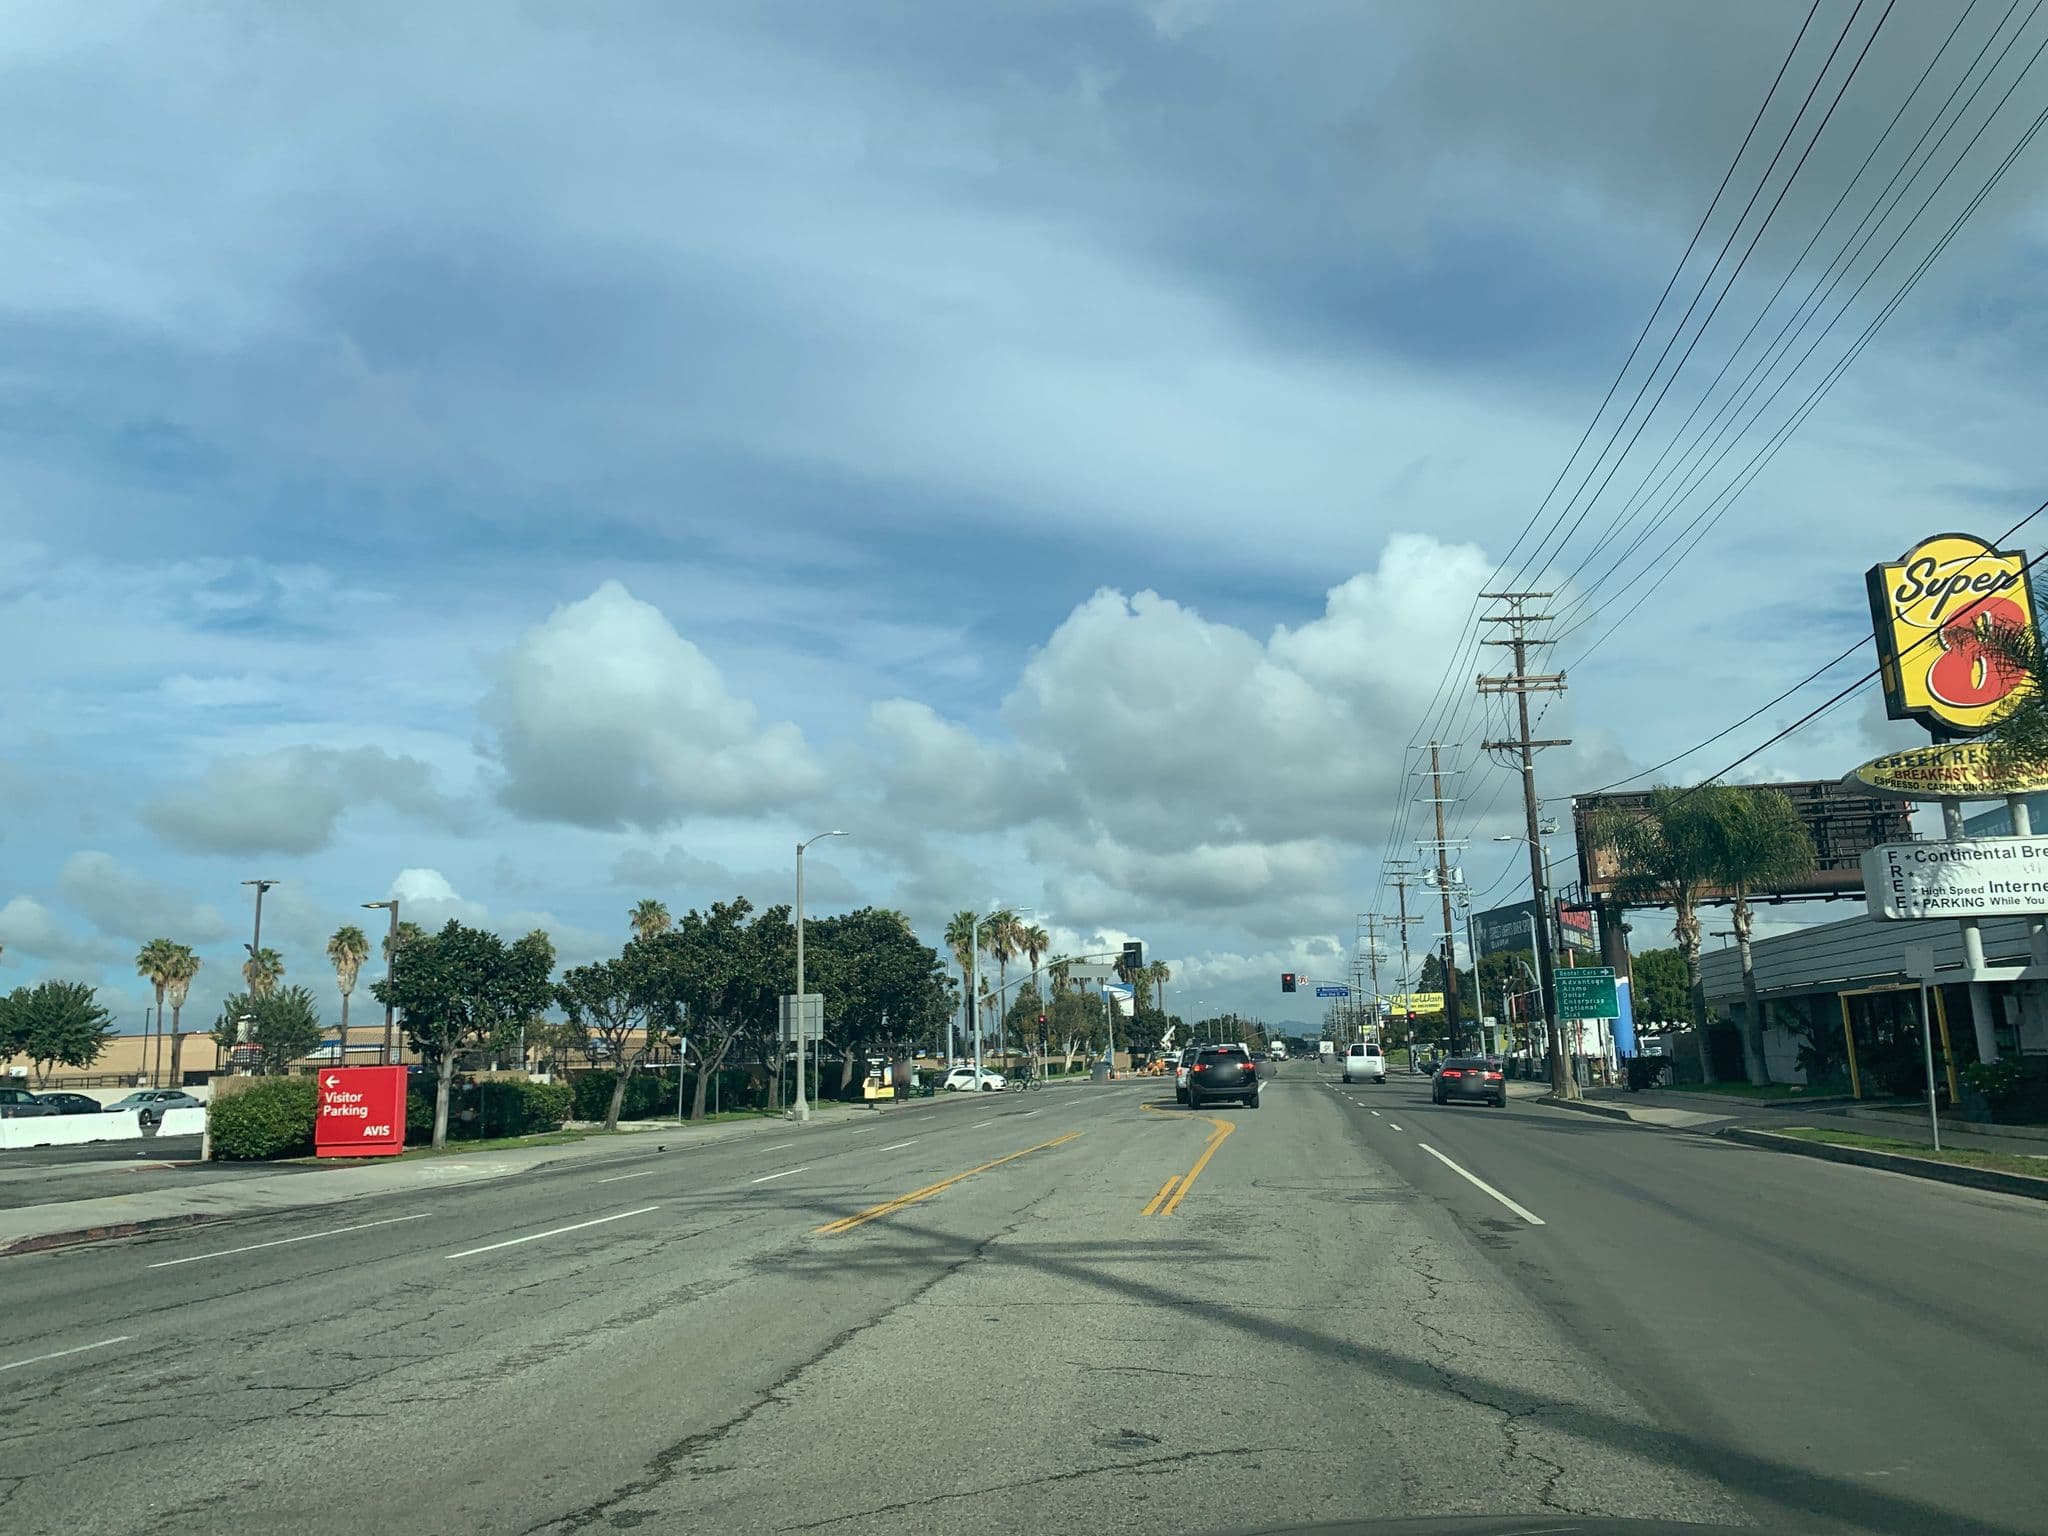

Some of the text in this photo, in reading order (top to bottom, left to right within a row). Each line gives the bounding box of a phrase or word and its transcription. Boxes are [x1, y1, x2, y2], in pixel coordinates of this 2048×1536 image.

[1896, 557, 2019, 620] Super
[1874, 753, 1944, 769] GREEK
[1894, 767, 1968, 782] BREAKFAST
[1874, 776, 1919, 790] ESPRESSO
[1927, 782, 1984, 792] CAPPUCCINO
[1914, 846, 2017, 863] Continental
[1921, 881, 2048, 897] High Speed Interne
[1923, 896, 2045, 909] PARKING While You
[325, 1092, 363, 1103] Visitor
[323, 1104, 368, 1118] Parking
[363, 1125, 390, 1136] AVIS
